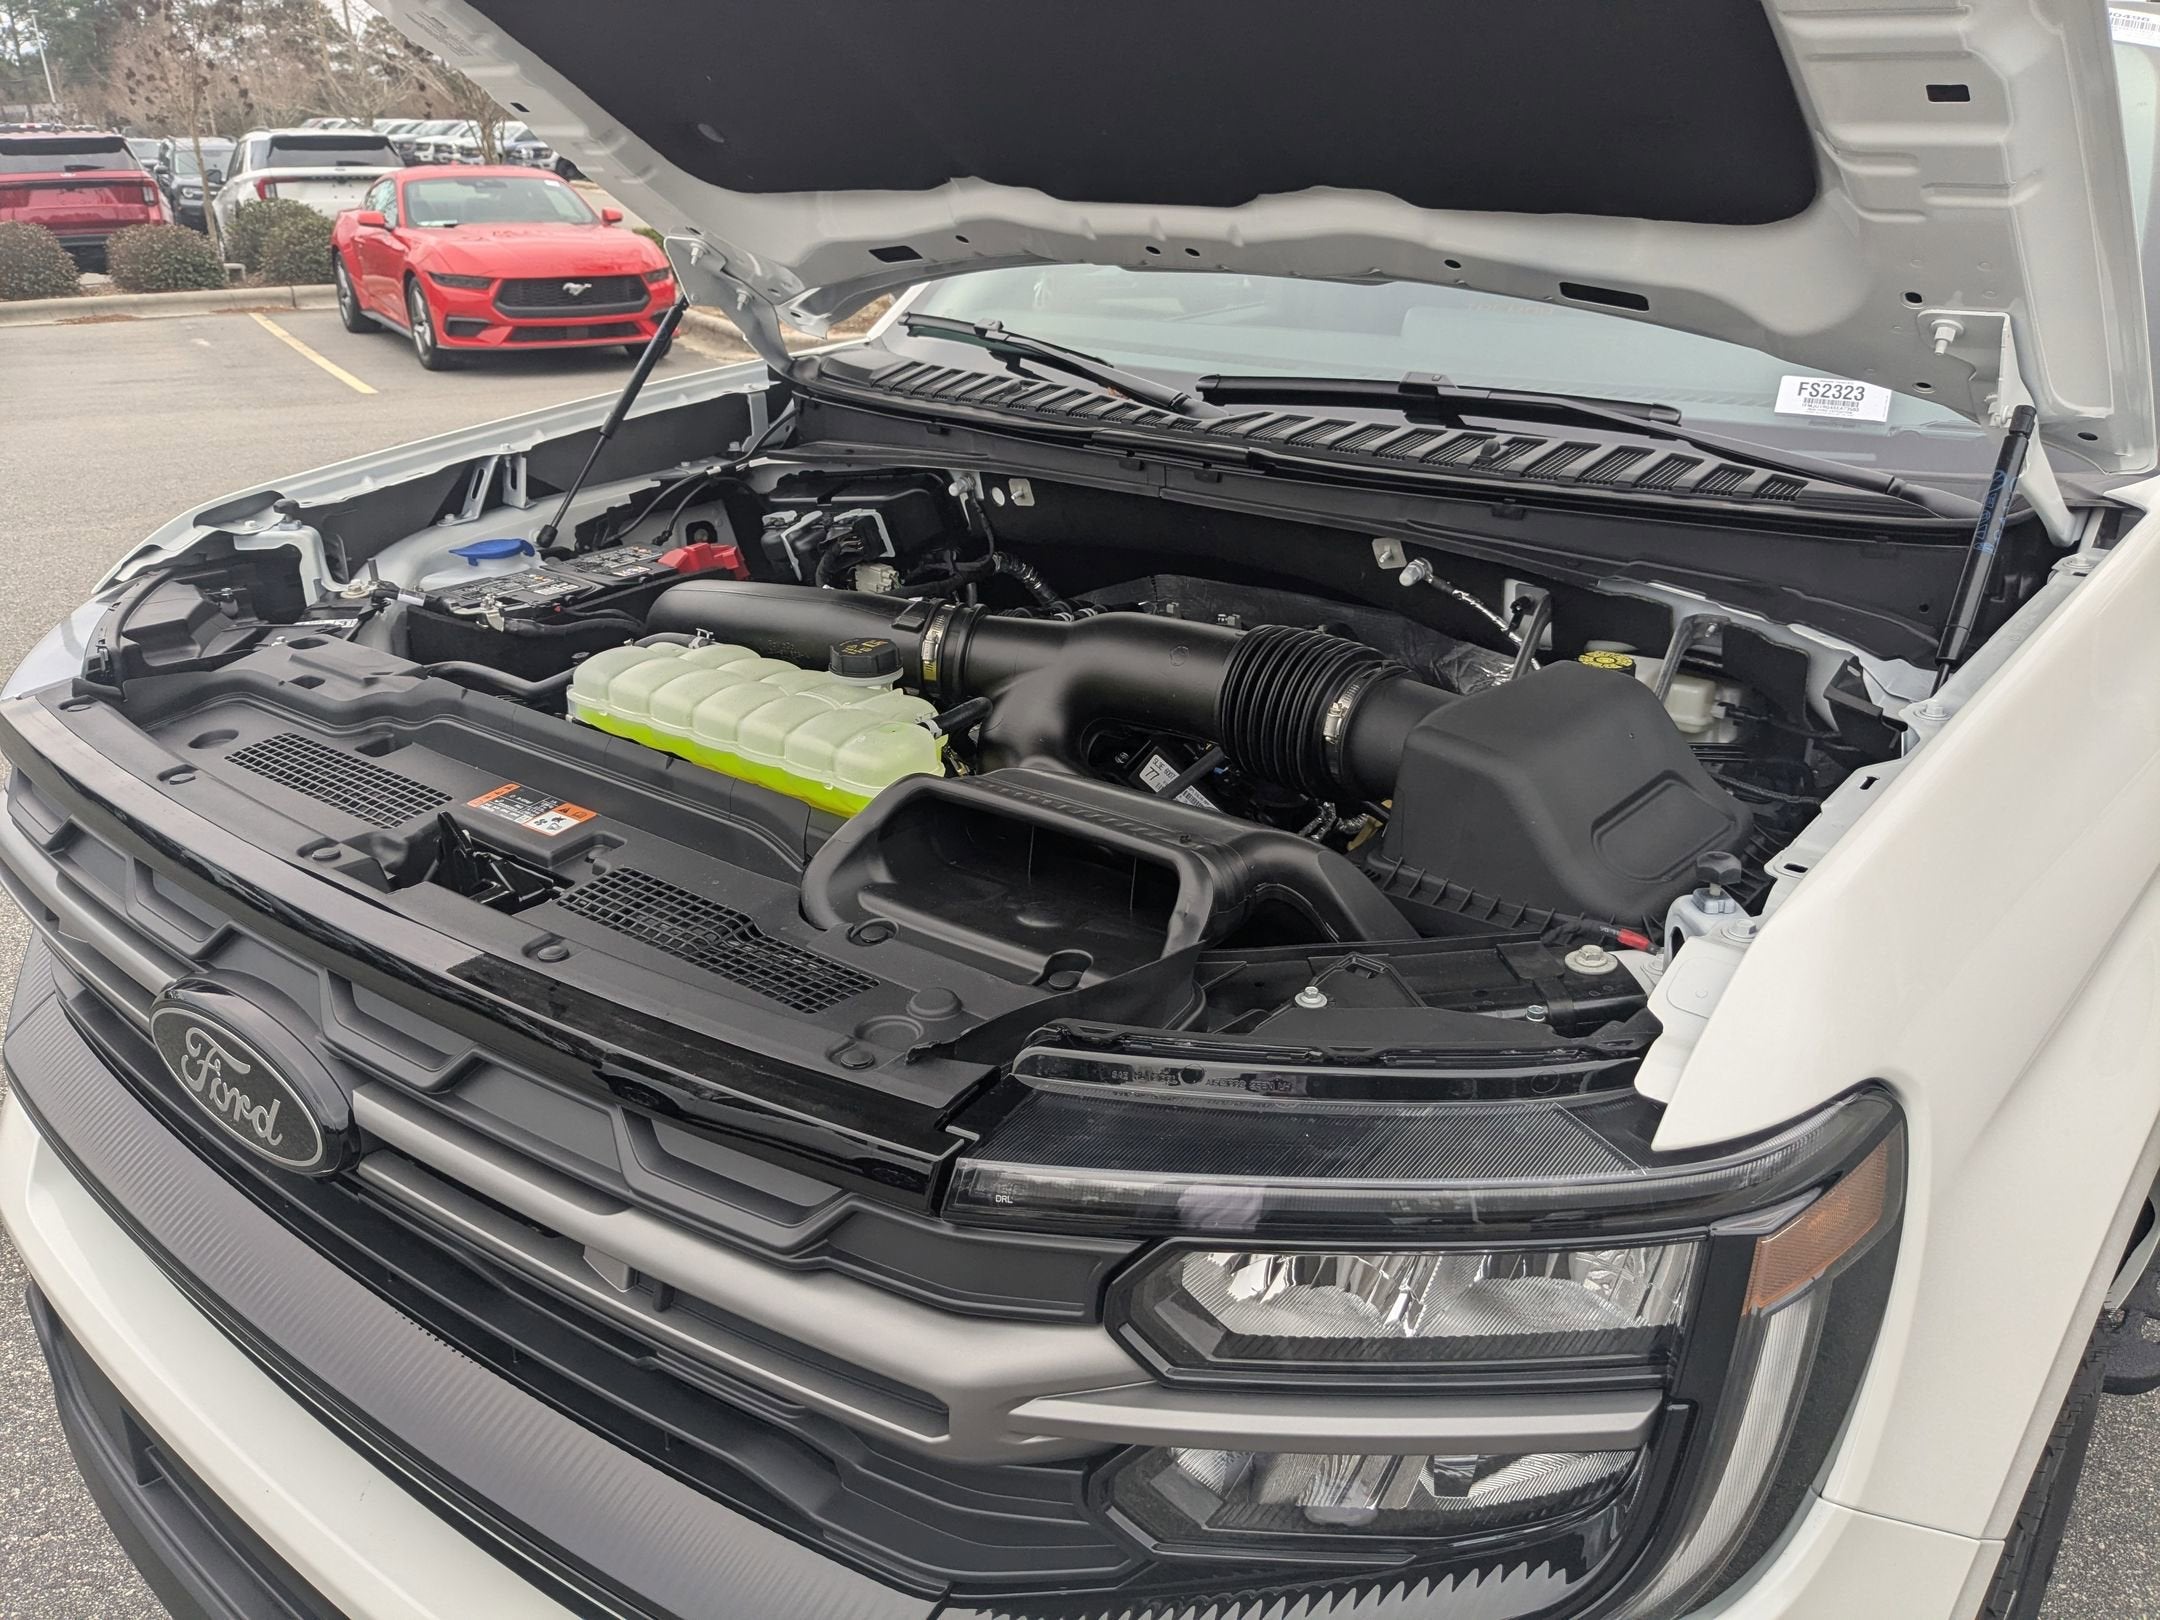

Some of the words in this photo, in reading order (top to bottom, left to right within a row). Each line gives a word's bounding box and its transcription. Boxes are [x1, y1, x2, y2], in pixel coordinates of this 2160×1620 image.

[1797, 381, 1866, 402] FS2323
[1144, 766, 1160, 781] 77
[180, 1026, 283, 1146] Ford
[995, 1194, 1014, 1204] DRL
